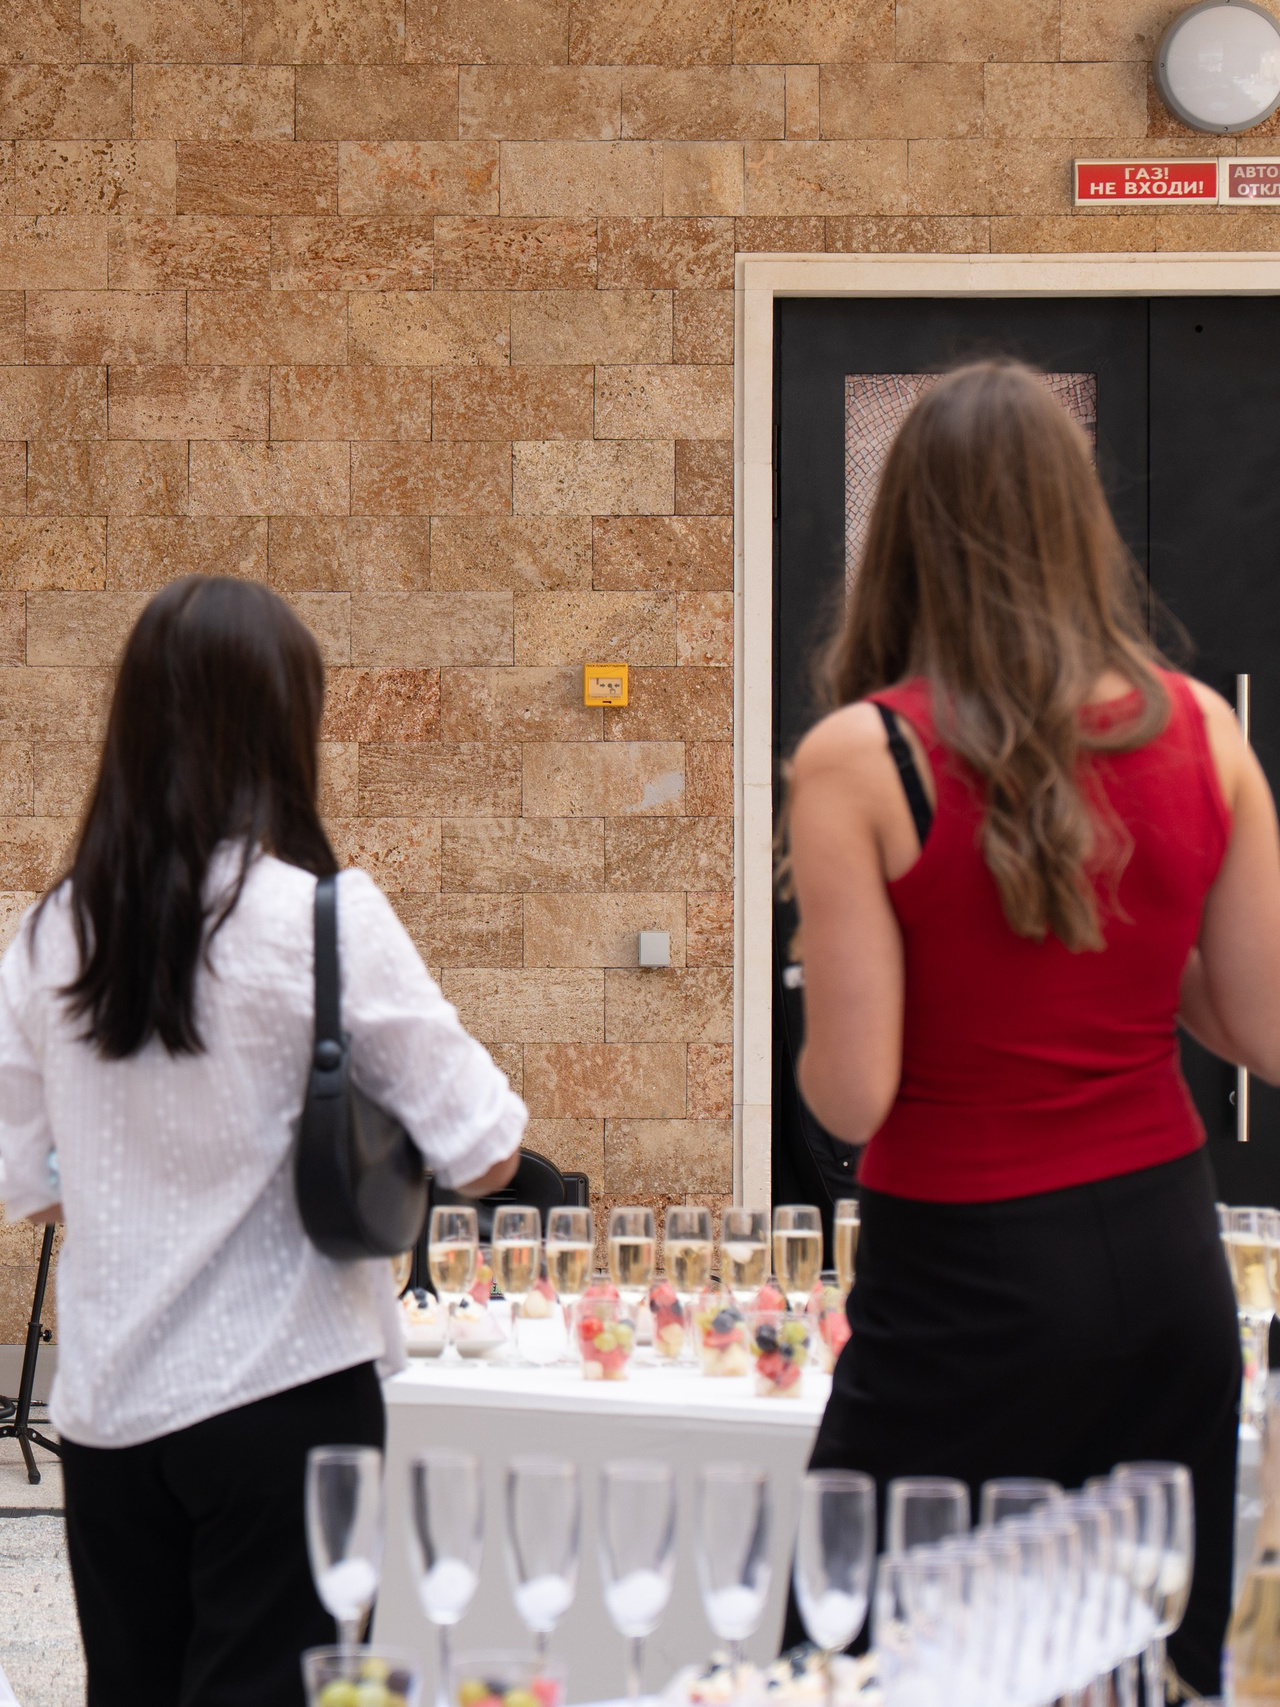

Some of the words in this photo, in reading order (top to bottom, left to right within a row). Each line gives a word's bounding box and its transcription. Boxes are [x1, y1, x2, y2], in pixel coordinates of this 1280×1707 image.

[1124, 167, 1169, 180] ГАЗ!
[1090, 182, 1117, 195] НЕ
[1124, 181, 1204, 195] ВХОДИ!
